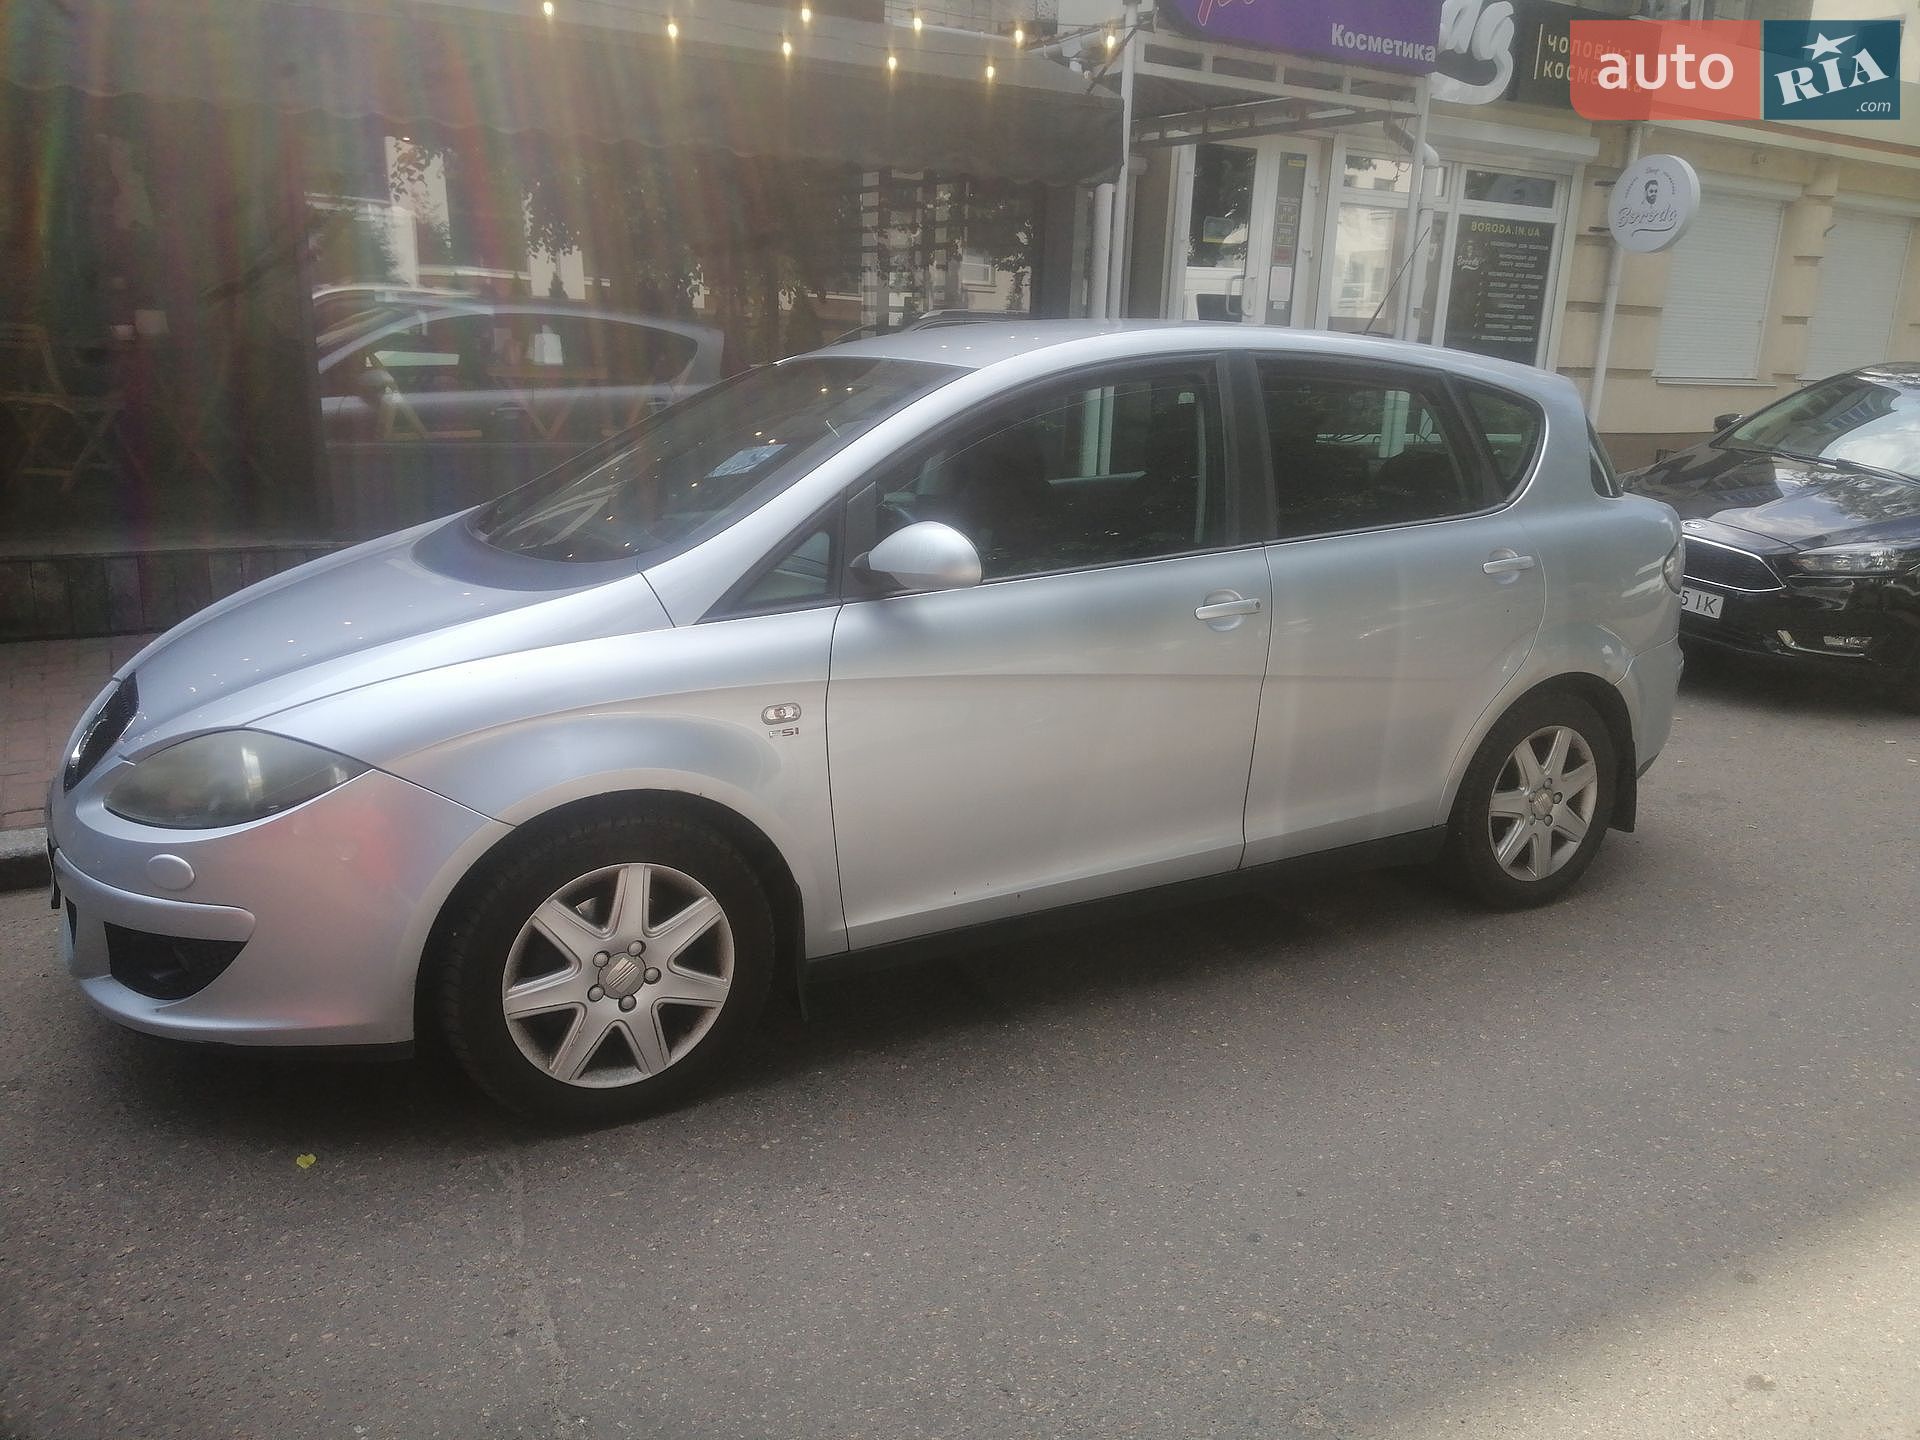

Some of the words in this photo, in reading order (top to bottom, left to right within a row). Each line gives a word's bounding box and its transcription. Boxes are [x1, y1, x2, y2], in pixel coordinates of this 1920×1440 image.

[1331, 23, 1436, 63] Косметика
[1471, 221, 1540, 237] BORODA.IN.UA
[1696, 594, 1718, 615] IK
